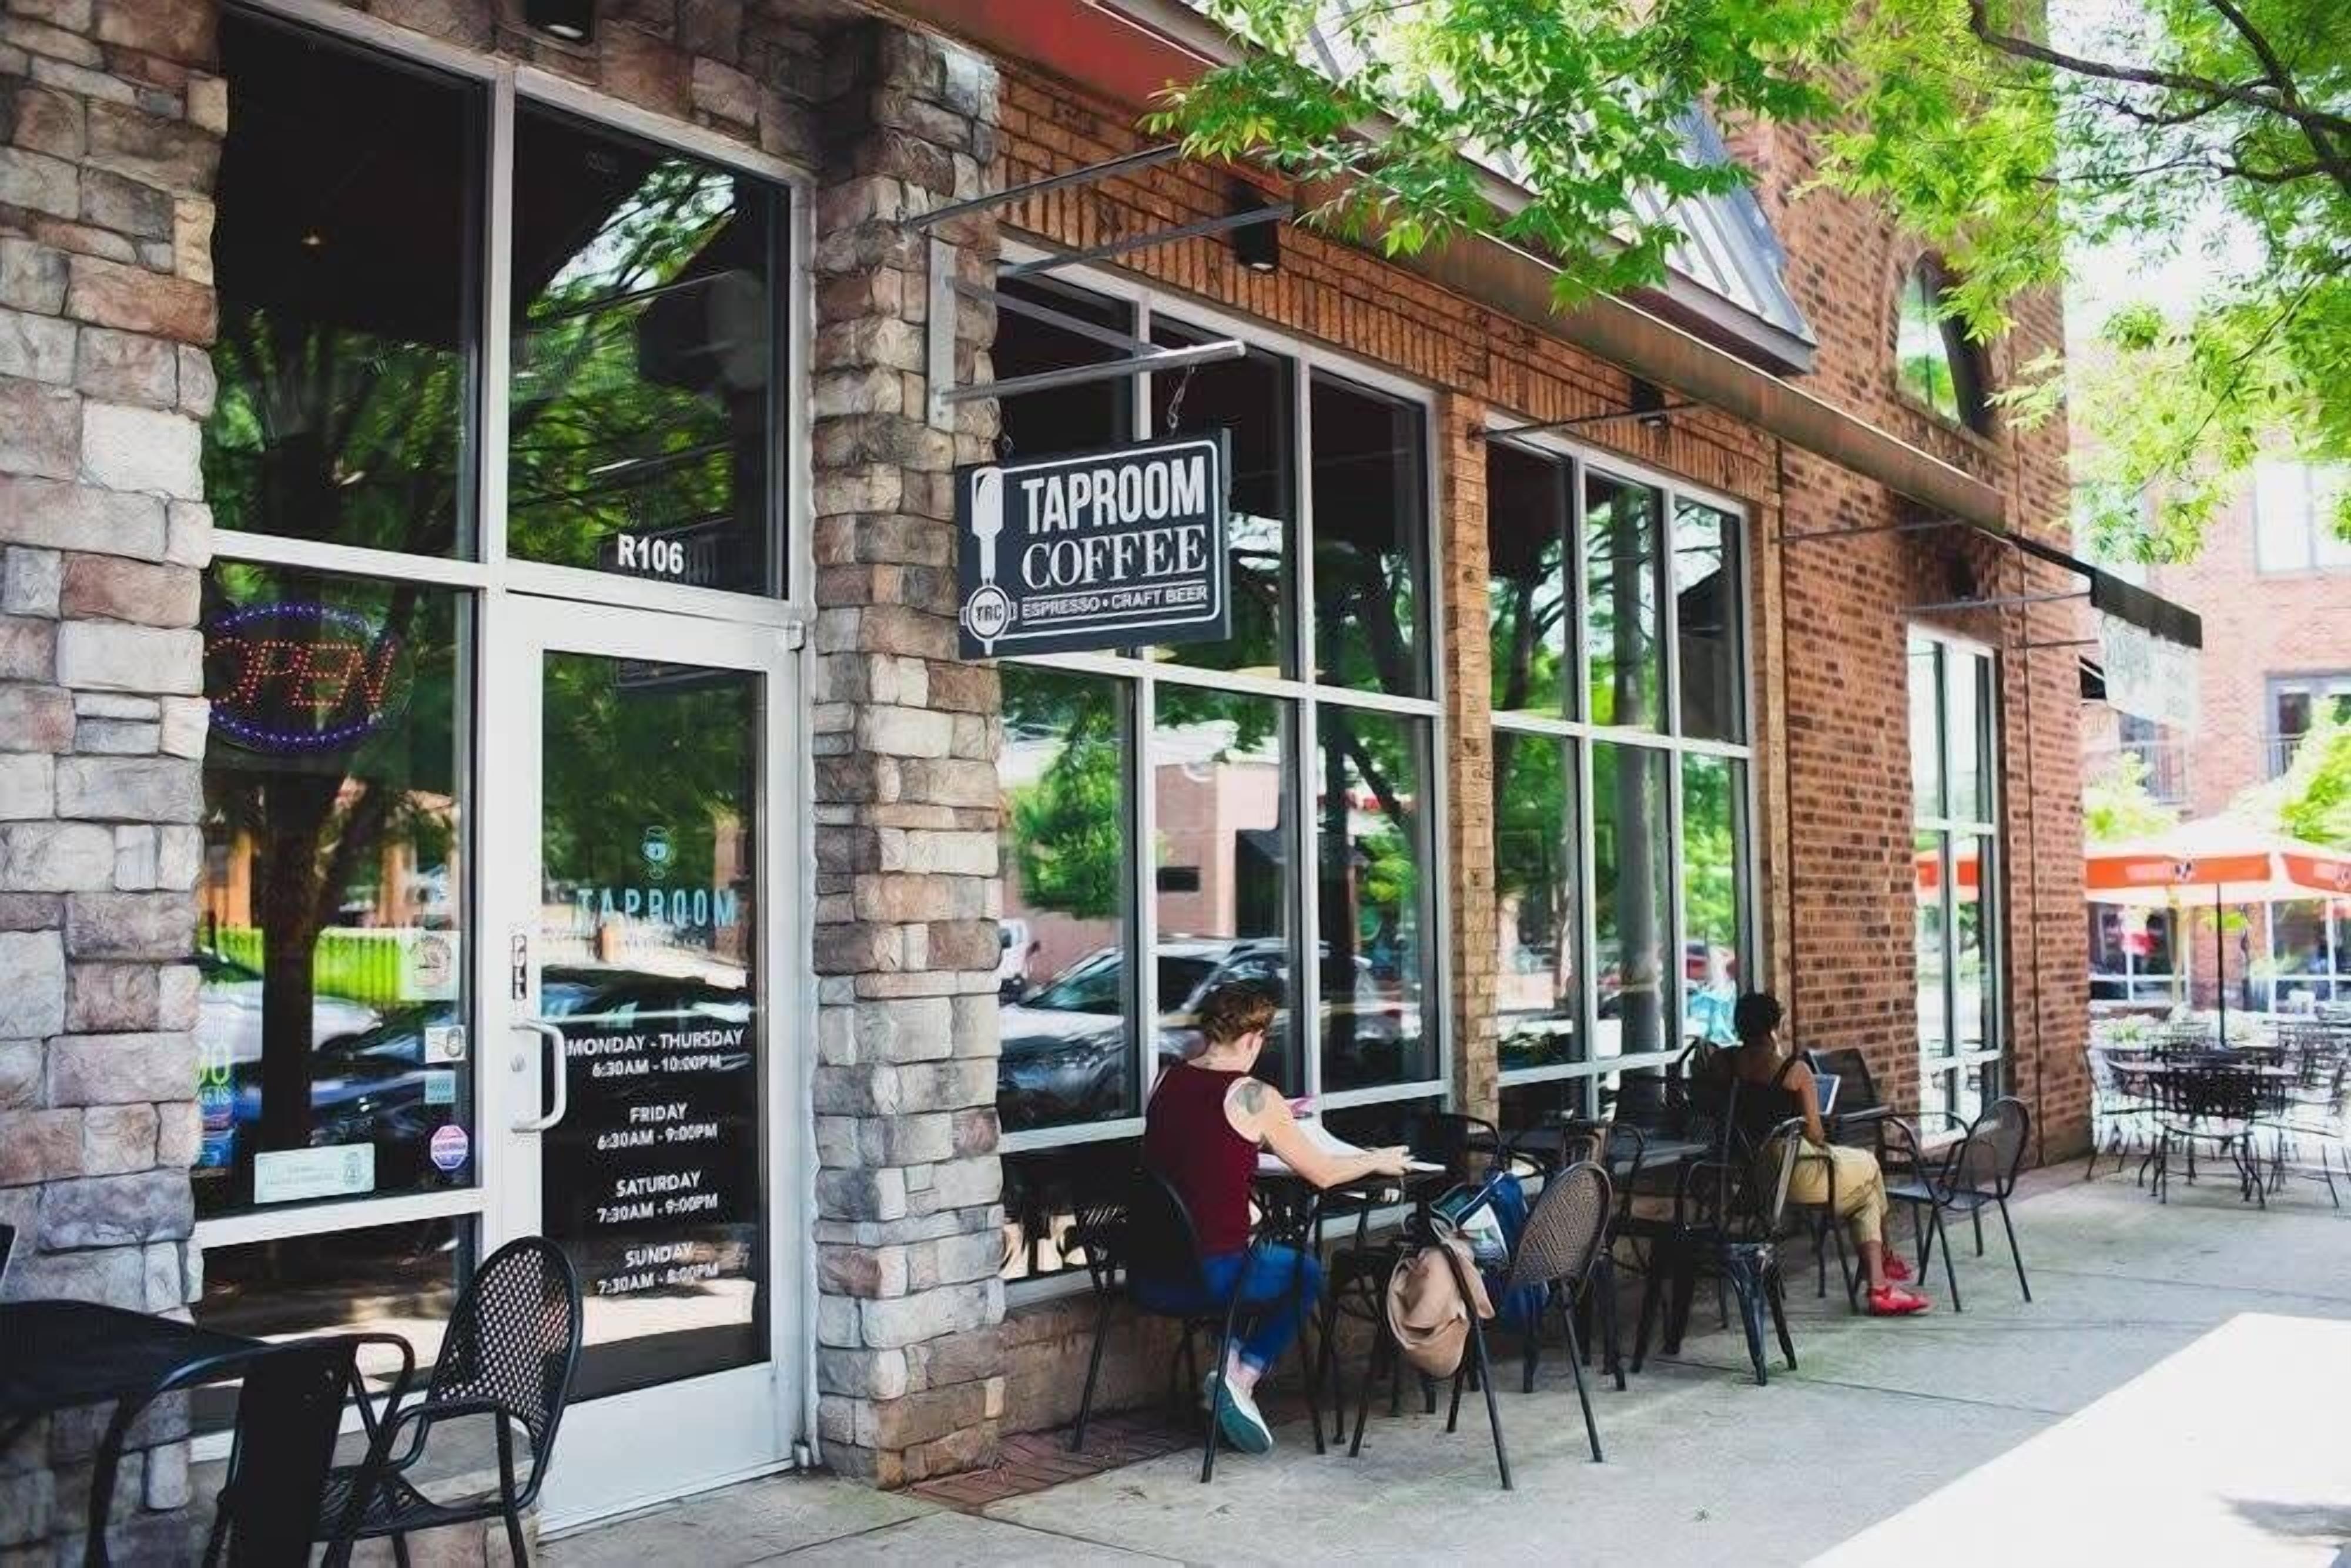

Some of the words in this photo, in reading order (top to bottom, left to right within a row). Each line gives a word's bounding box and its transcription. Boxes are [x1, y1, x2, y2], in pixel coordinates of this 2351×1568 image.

[1022, 455, 1205, 535] TAPROOM
[618, 533, 684, 574] R106
[1021, 524, 1207, 590] COFFEE
[1022, 595, 1100, 618] ESPRESSO
[1111, 589, 1161, 609] CRAFT
[1165, 586, 1208, 604] BEER
[202, 635, 401, 710] OPEN
[575, 886, 737, 927] TAPROOM
[564, 1034, 646, 1057] MONDAY
[659, 1028, 745, 1050] THURSDAY
[592, 1060, 649, 1078] 6:30AM
[629, 1102, 688, 1123] FRIDAY
[598, 1129, 654, 1150] 6:30AM
[616, 1170, 702, 1198] SATURDAY
[597, 1201, 655, 1223] 7:30AM
[624, 1241, 695, 1268] SUNDAY
[597, 1272, 655, 1295] 7:30AM
